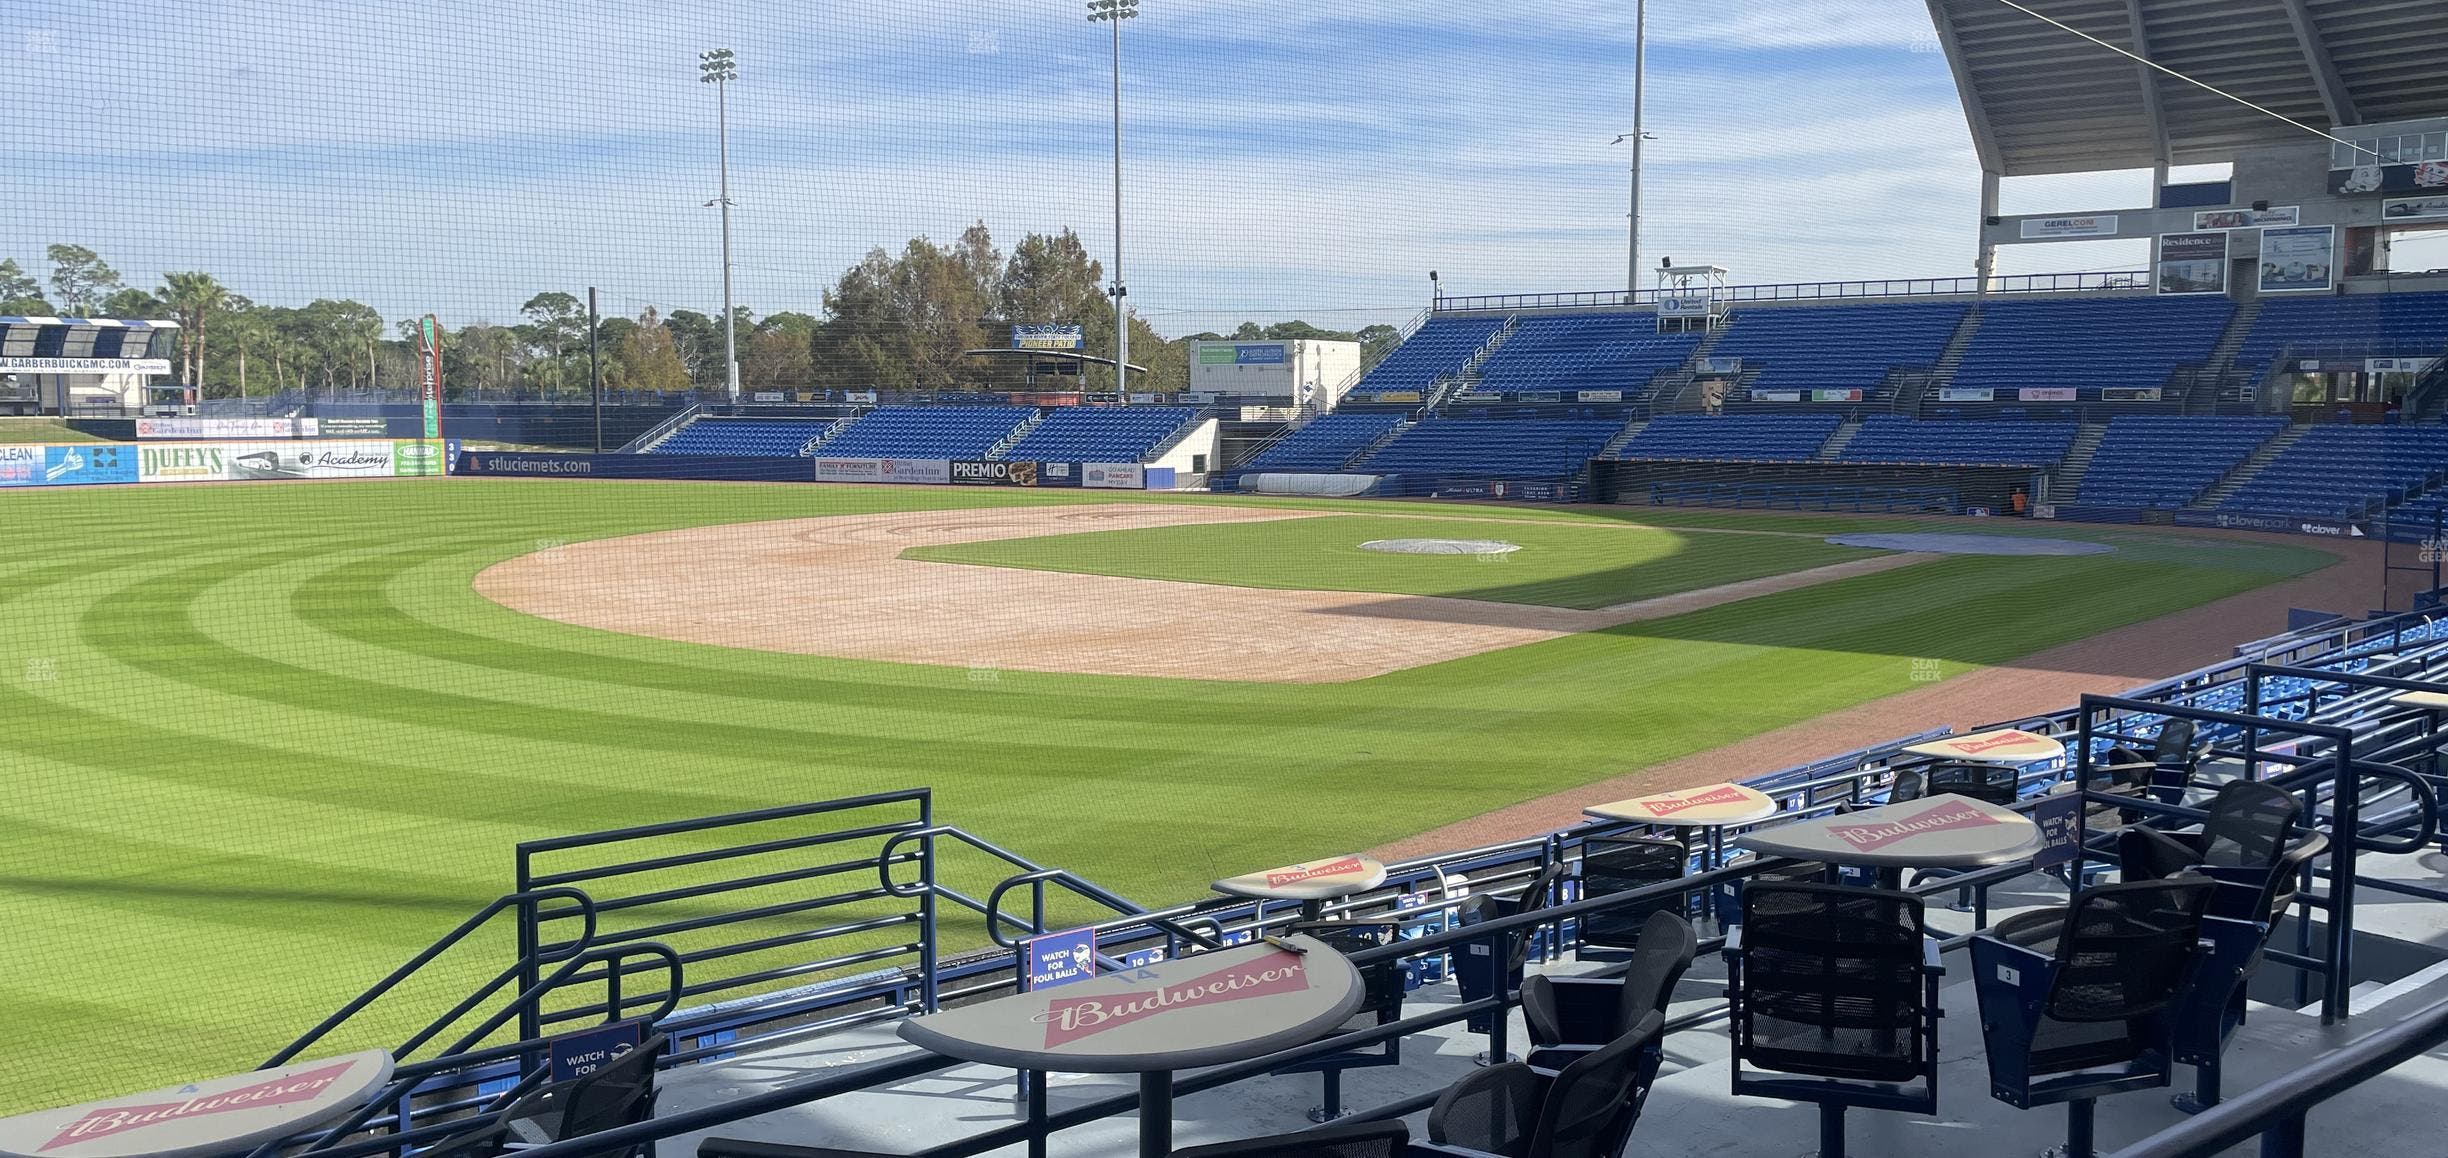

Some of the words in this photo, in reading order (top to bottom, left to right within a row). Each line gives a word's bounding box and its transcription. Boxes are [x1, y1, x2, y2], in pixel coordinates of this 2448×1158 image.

[2162, 238, 2212, 247] Residence
[1019, 340, 1052, 348] PIONEER
[1053, 340, 1075, 348] PATIO
[318, 451, 390, 470] Academy
[488, 456, 591, 473] stluciemets.com
[953, 463, 1007, 478] PREMIO
[2311, 524, 2341, 535] clover
[1645, 791, 1742, 812] Budweiser
[1826, 809, 1984, 844] Budweiser
[2042, 816, 2063, 828] WATCH
[2046, 827, 2058, 837] FOR
[2051, 836, 2068, 847] BALLS
[1271, 862, 1361, 885] Budweiser
[1041, 950, 1070, 963] WATCH
[1047, 961, 1064, 971] FOR
[1033, 973, 1055, 985] FOUL
[1055, 967, 1078, 980] BALLS
[2005, 969, 2012, 981] 3
[1029, 963, 1306, 1032] Budweiser
[566, 1050, 605, 1066] WATCH
[575, 1063, 597, 1076] FOR
[56, 1076, 338, 1137] Budweiser
